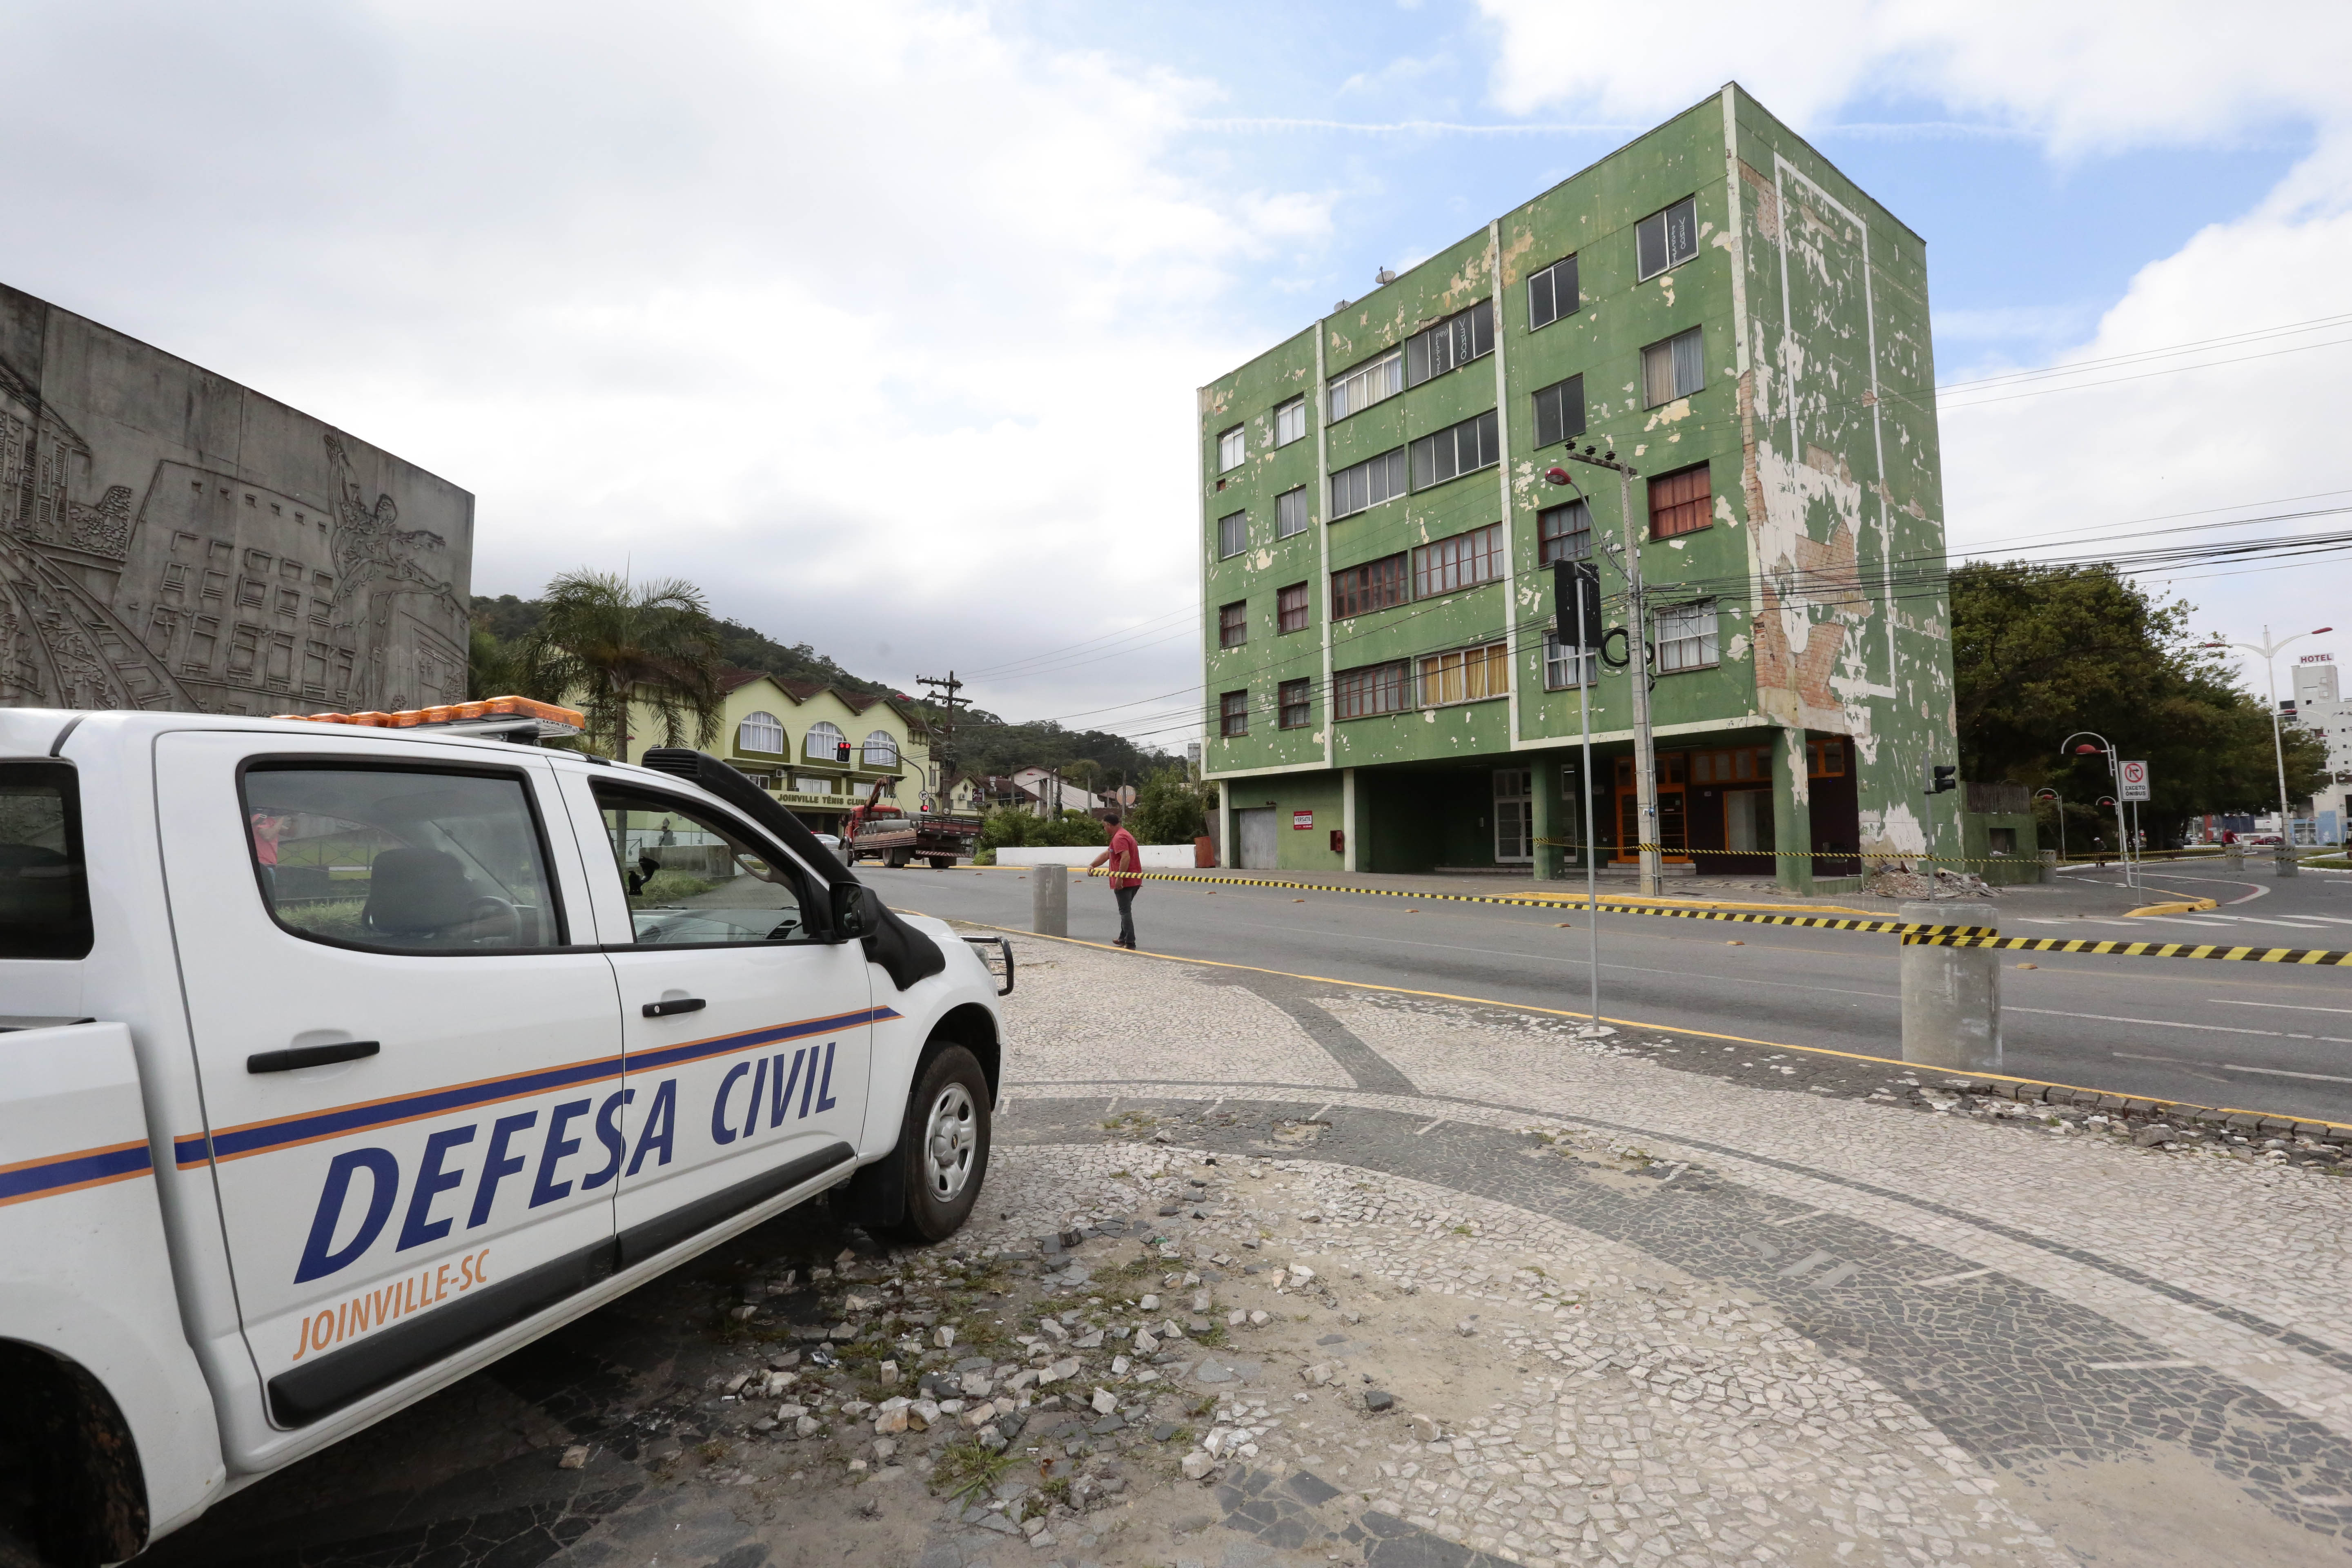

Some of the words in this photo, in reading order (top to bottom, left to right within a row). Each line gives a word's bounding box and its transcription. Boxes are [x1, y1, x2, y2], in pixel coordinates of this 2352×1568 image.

[2301, 654, 2332, 663] HOTEL
[777, 794, 819, 804] JOINVILLE
[822, 795, 844, 804] TÊNIS
[294, 1078, 677, 1284] DEFESA
[712, 1042, 836, 1145] CIVIL
[292, 1248, 490, 1361] JOINVILLE-SC
